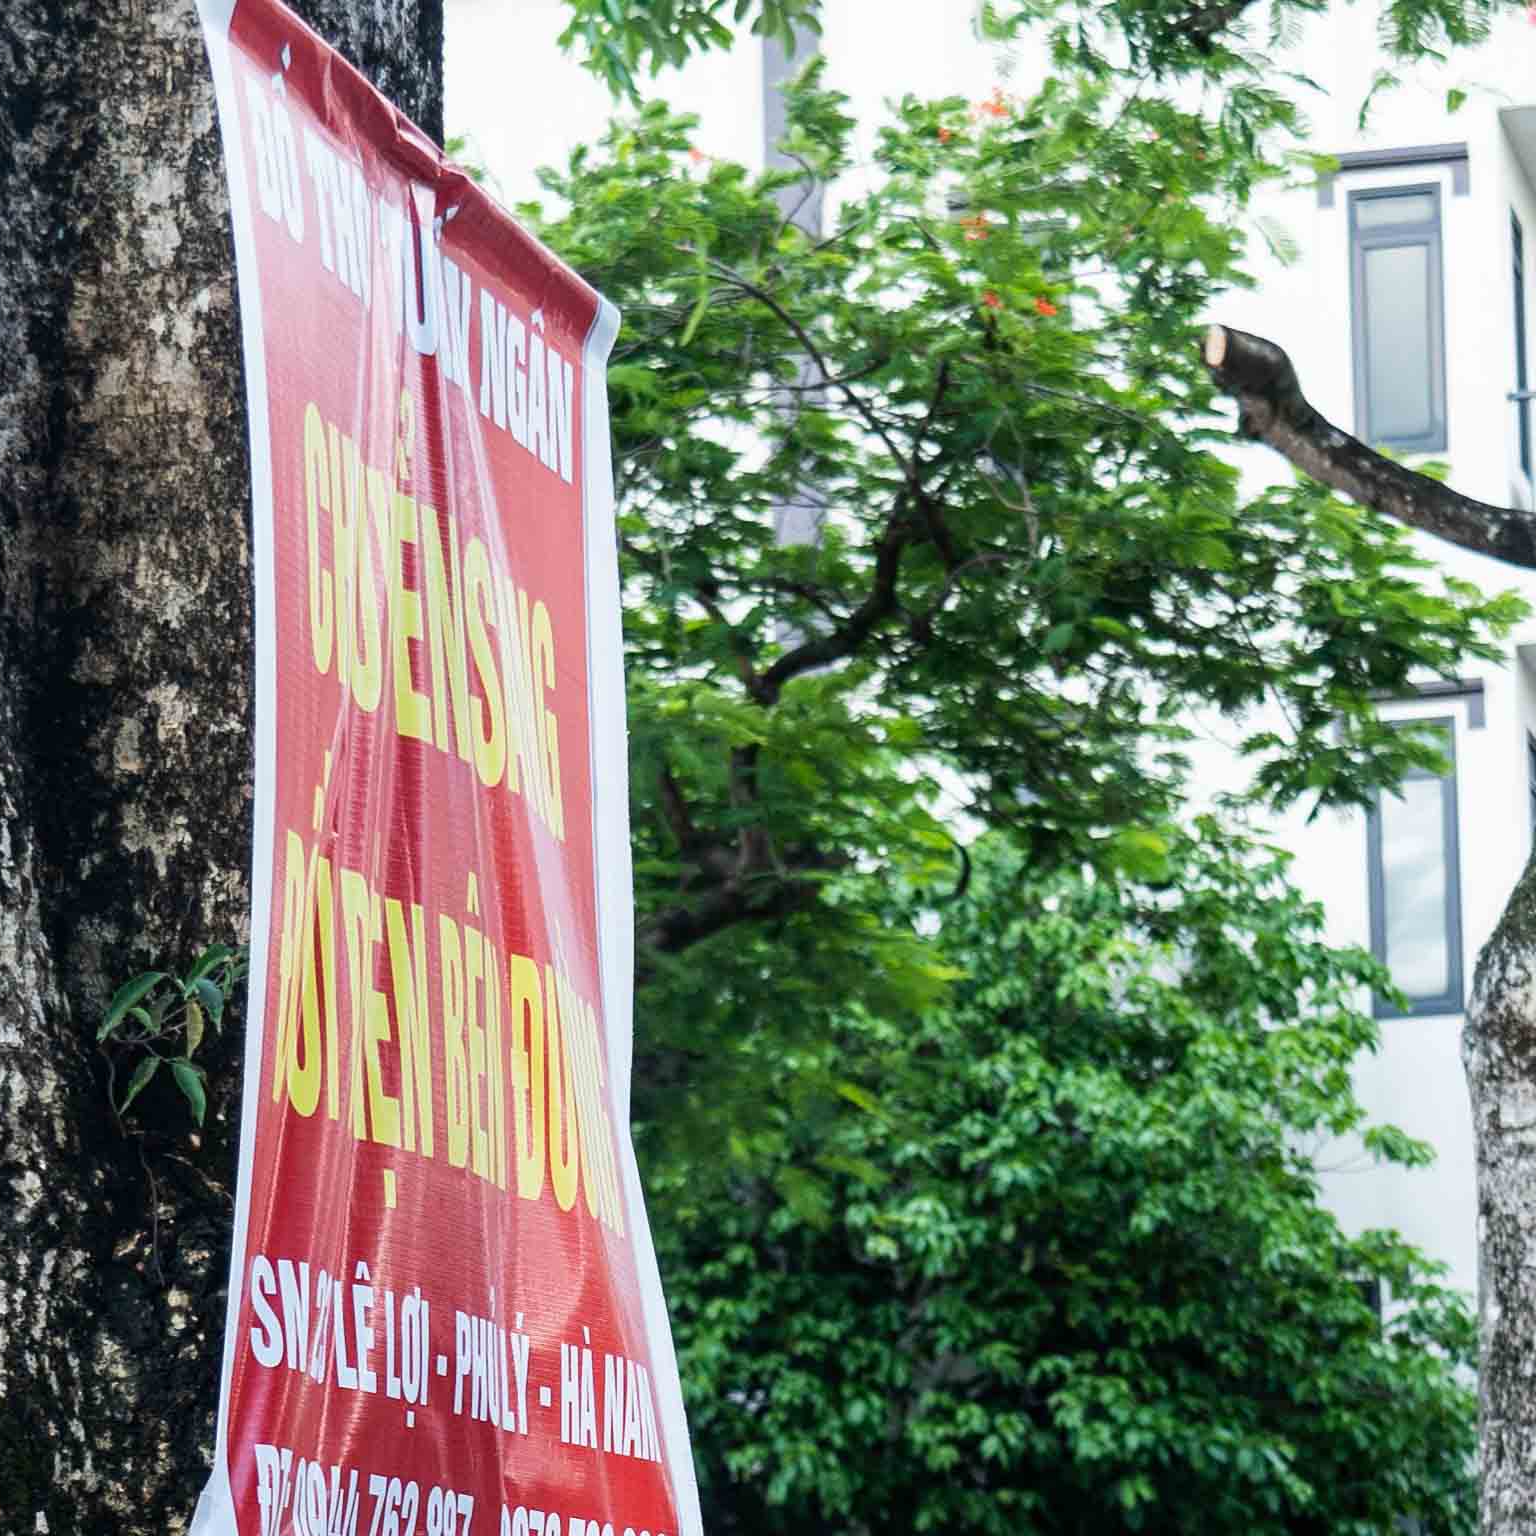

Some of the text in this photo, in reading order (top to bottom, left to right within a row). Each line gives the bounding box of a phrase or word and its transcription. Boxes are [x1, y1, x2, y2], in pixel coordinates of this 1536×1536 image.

[478, 286, 575, 486] NGÂN
[439, 871, 506, 1192] BÊN
[250, 1255, 311, 1373] SN
[333, 1260, 378, 1394] LÊ
[384, 1286, 431, 1428] LỢI
[437, 1355, 449, 1377] -
[540, 1386, 552, 1407] -
[560, 1326, 597, 1450] HÀ
[603, 1353, 663, 1465] NAM
